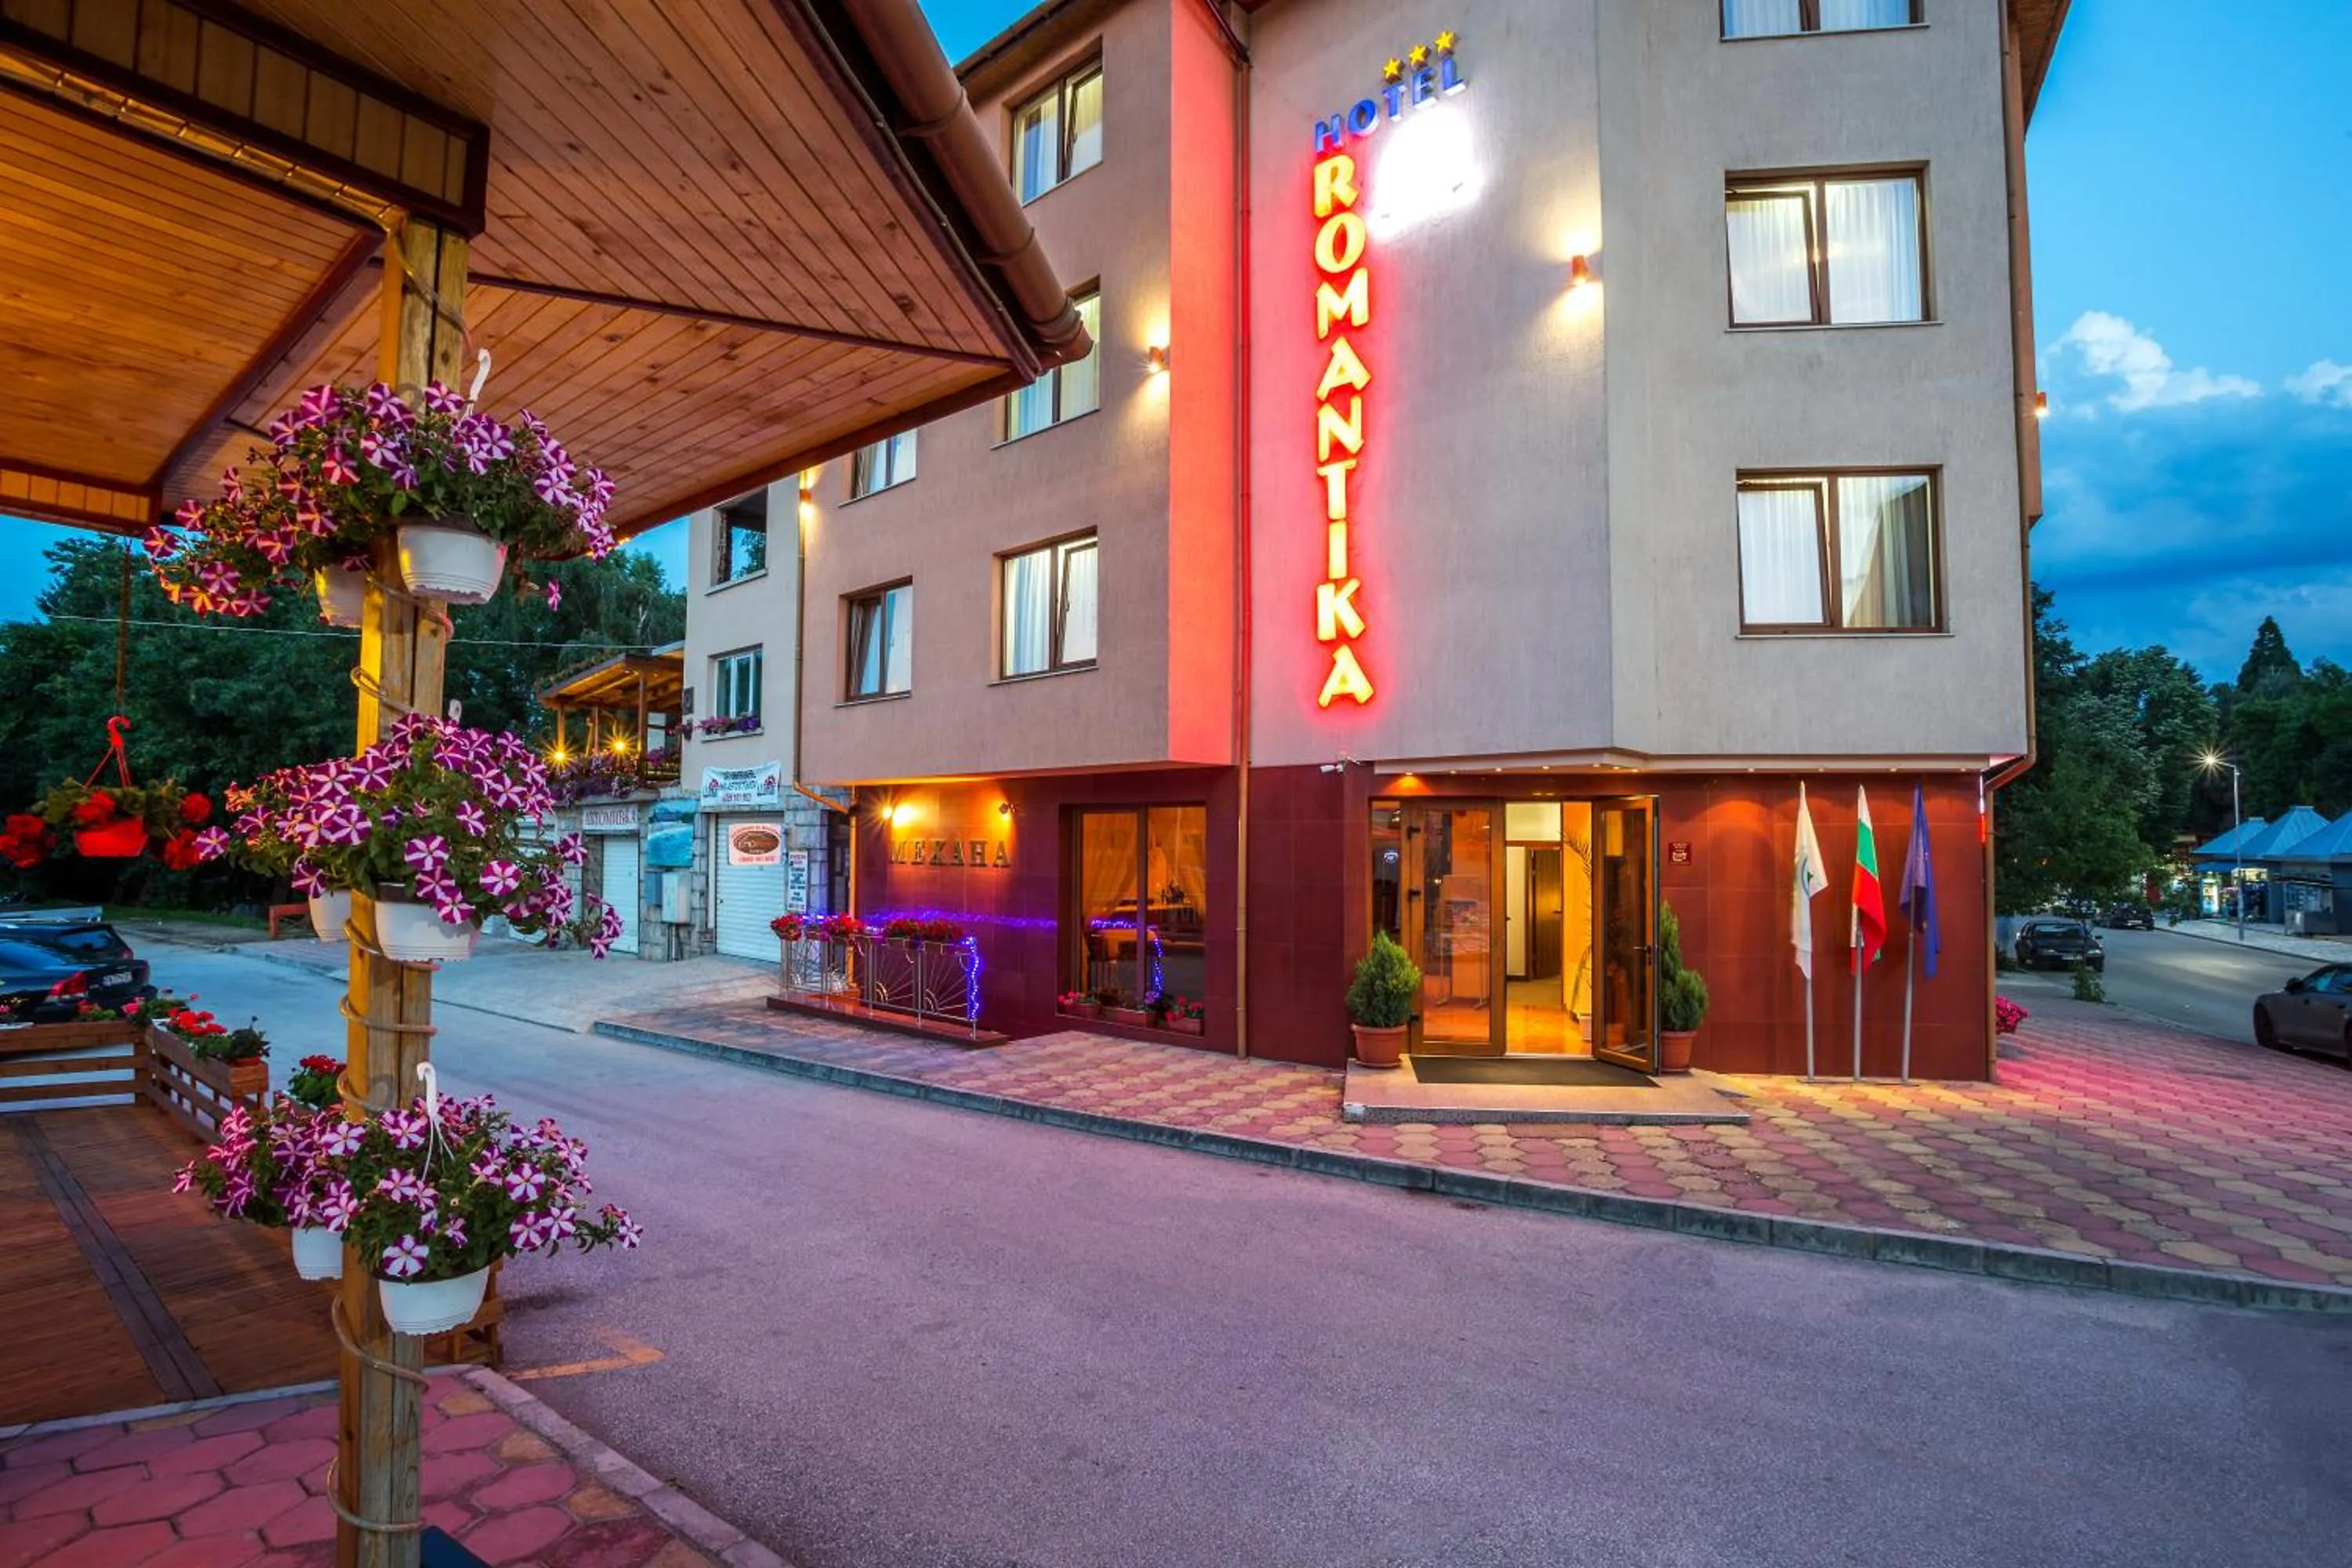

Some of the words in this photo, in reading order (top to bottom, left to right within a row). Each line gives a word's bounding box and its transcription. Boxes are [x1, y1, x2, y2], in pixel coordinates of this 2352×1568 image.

[1315, 57, 1466, 154] HOTEL
[1313, 154, 1374, 708] ROMANTIKA
[890, 837, 1011, 867] МЕХАНА
